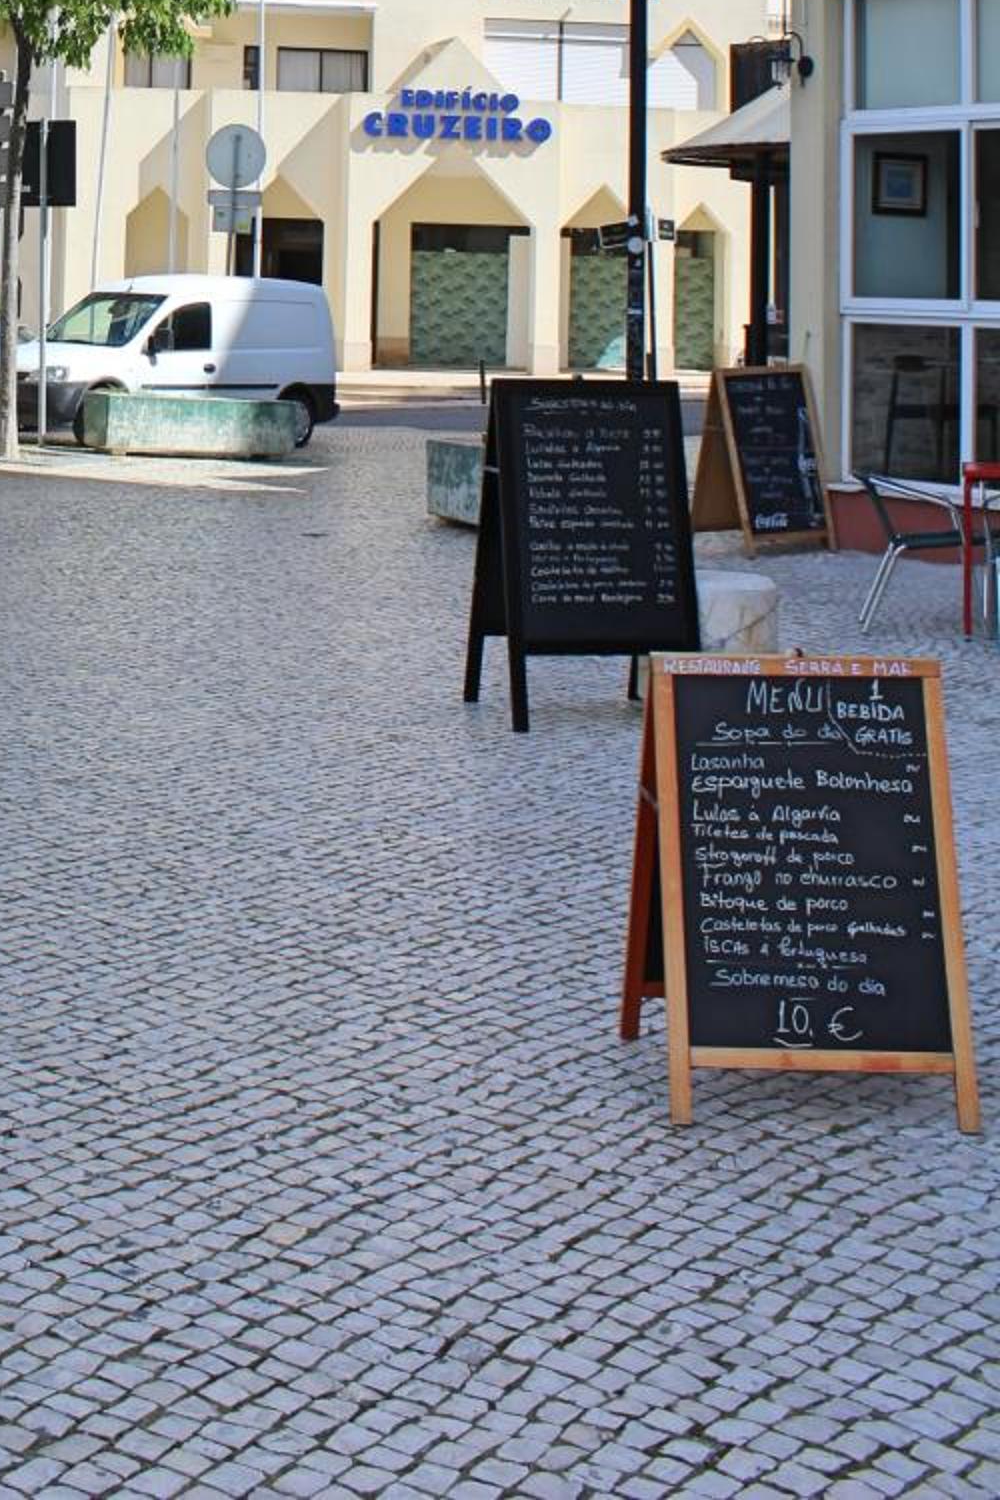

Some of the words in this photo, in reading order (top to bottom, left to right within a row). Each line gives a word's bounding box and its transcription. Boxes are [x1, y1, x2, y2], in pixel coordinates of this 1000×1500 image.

[401, 86, 519, 112] EDIFÍCIO
[363, 111, 552, 144] CRUZEIRO
[784, 659, 843, 675] SERRA
[852, 663, 864, 675] E
[869, 679, 884, 700] 1
[836, 701, 905, 720] BEBIDA
[711, 722, 771, 743] Sopa
[782, 723, 808, 739] do
[691, 753, 765, 771] Lasanha
[691, 770, 806, 798] Esparguete
[816, 769, 913, 793] Bolonhesa
[693, 800, 741, 822] Lulas
[772, 804, 842, 828] Algarvia
[756, 825, 774, 841] de
[786, 847, 803, 864] de
[812, 850, 855, 870] porco
[775, 873, 793, 885] no
[700, 890, 769, 913] Bitoque
[776, 896, 798, 912] de
[806, 896, 849, 916] porco
[787, 918, 804, 934] de
[710, 967, 820, 988] Sobremesa
[827, 975, 849, 993] do
[858, 977, 887, 996] dia
